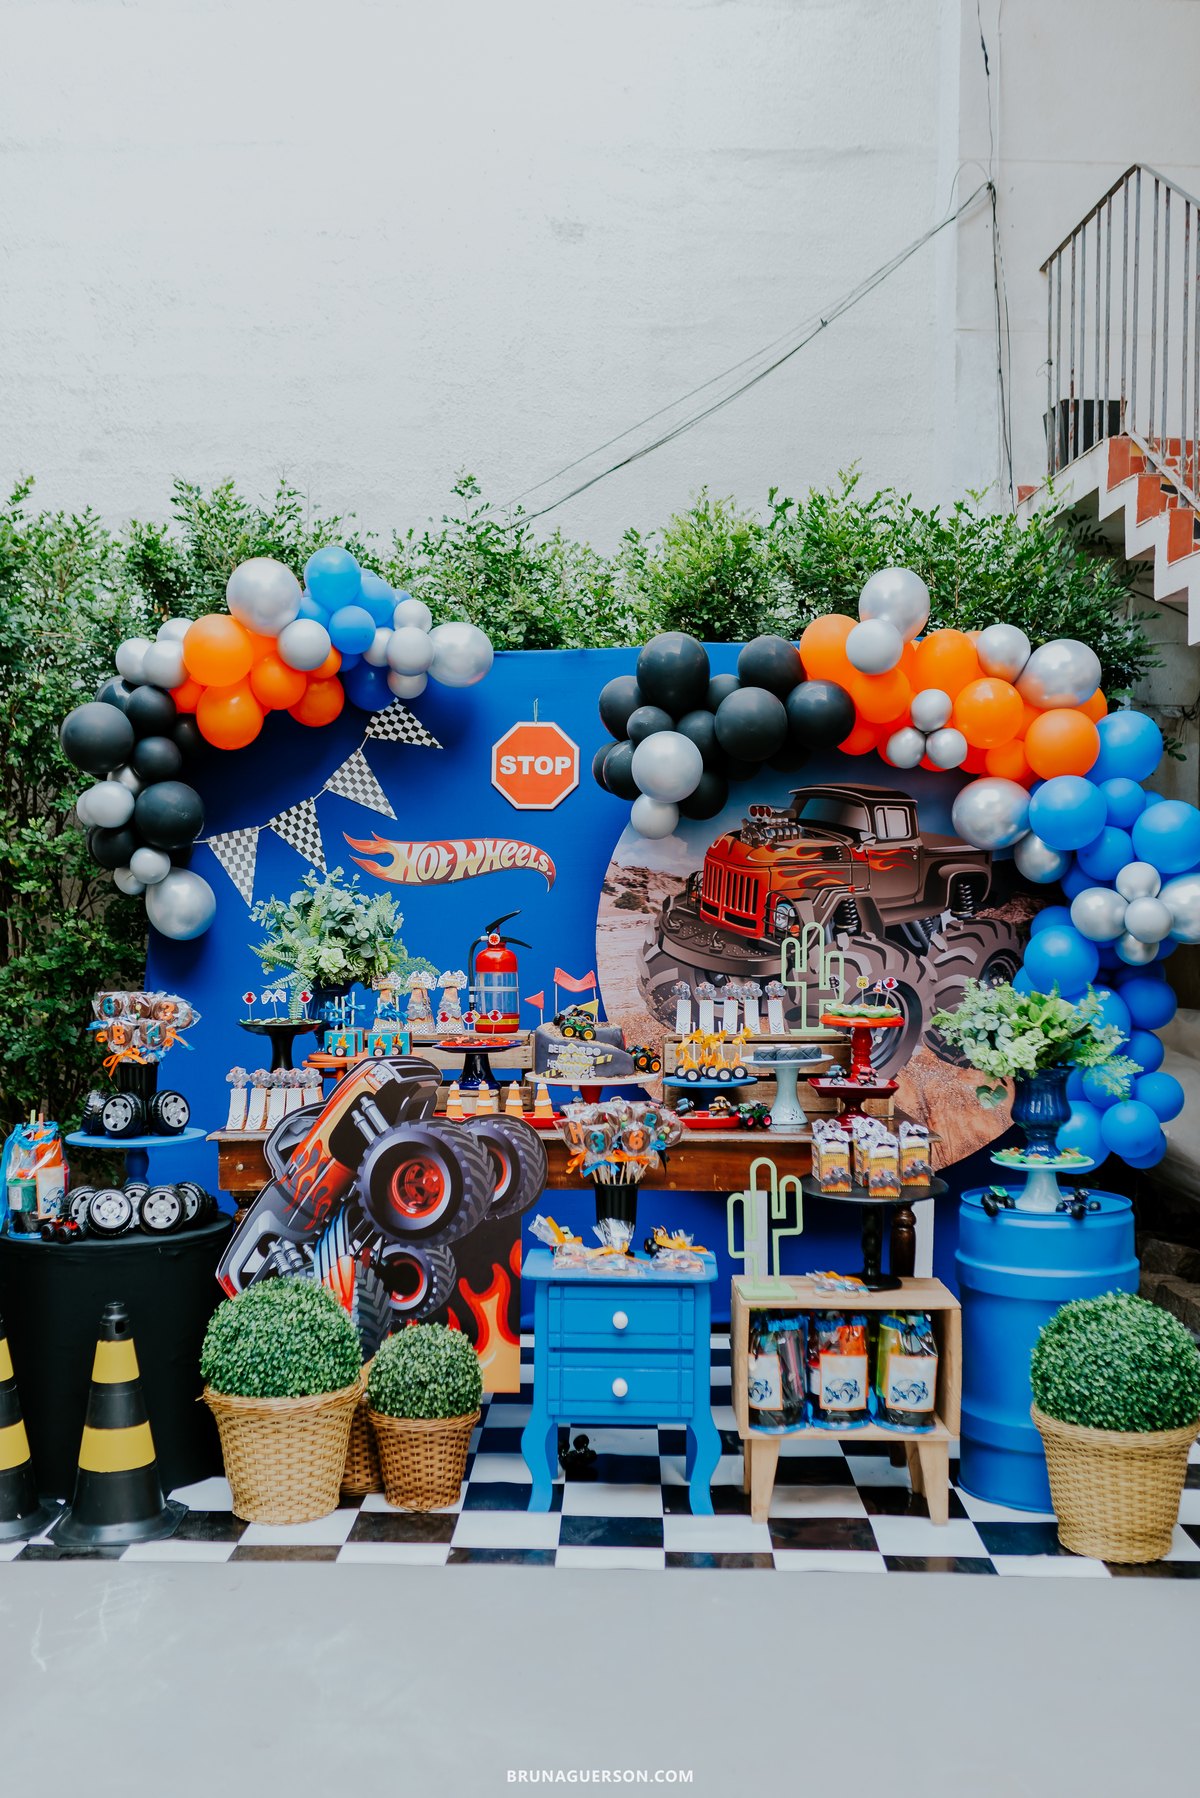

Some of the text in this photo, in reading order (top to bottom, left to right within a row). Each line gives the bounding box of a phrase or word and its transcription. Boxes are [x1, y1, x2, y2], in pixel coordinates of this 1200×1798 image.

[499, 755, 572, 775] STOP
[103, 997, 115, 1015] 6
[112, 1025, 126, 1045] B
[590, 1131, 605, 1152] 3
[628, 1130, 644, 1150] 6
